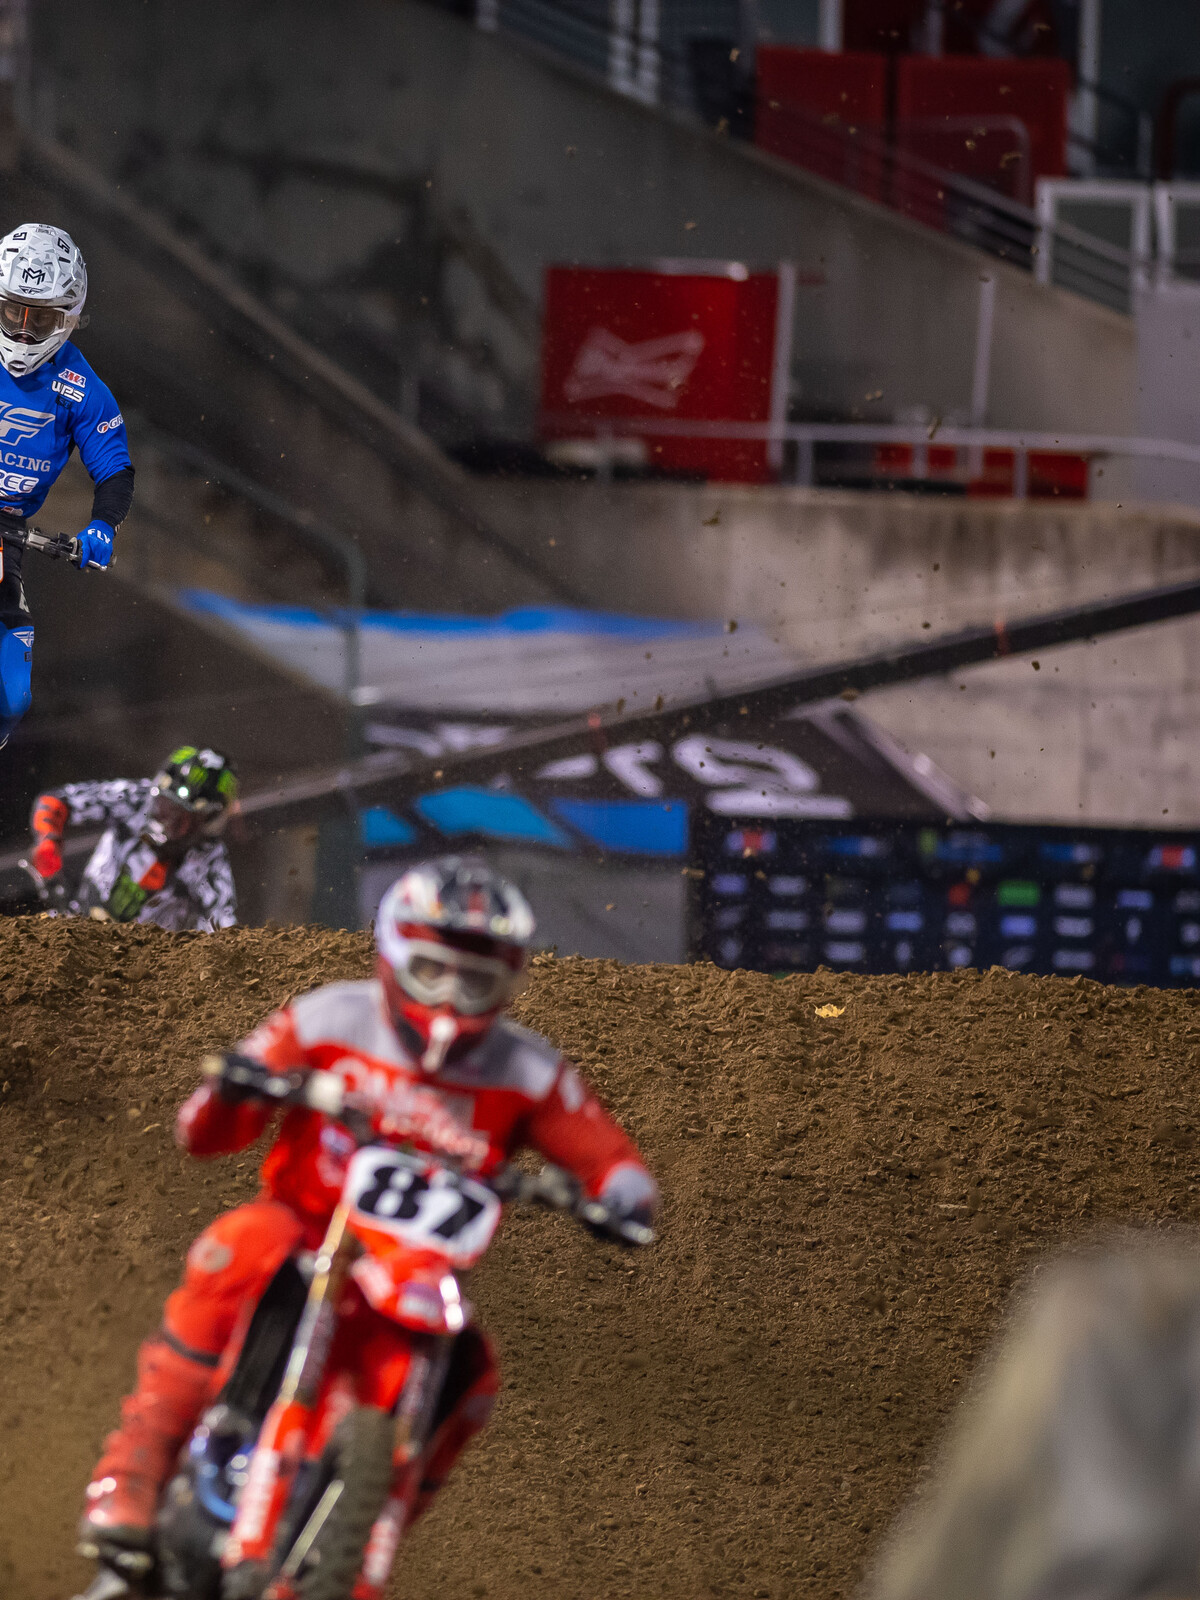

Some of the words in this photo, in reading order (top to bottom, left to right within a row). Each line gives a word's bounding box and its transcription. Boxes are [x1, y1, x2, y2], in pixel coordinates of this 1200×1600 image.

[58, 368, 86, 388] AMA
[87, 528, 111, 544] FLY
[357, 1167, 485, 1239] 87
